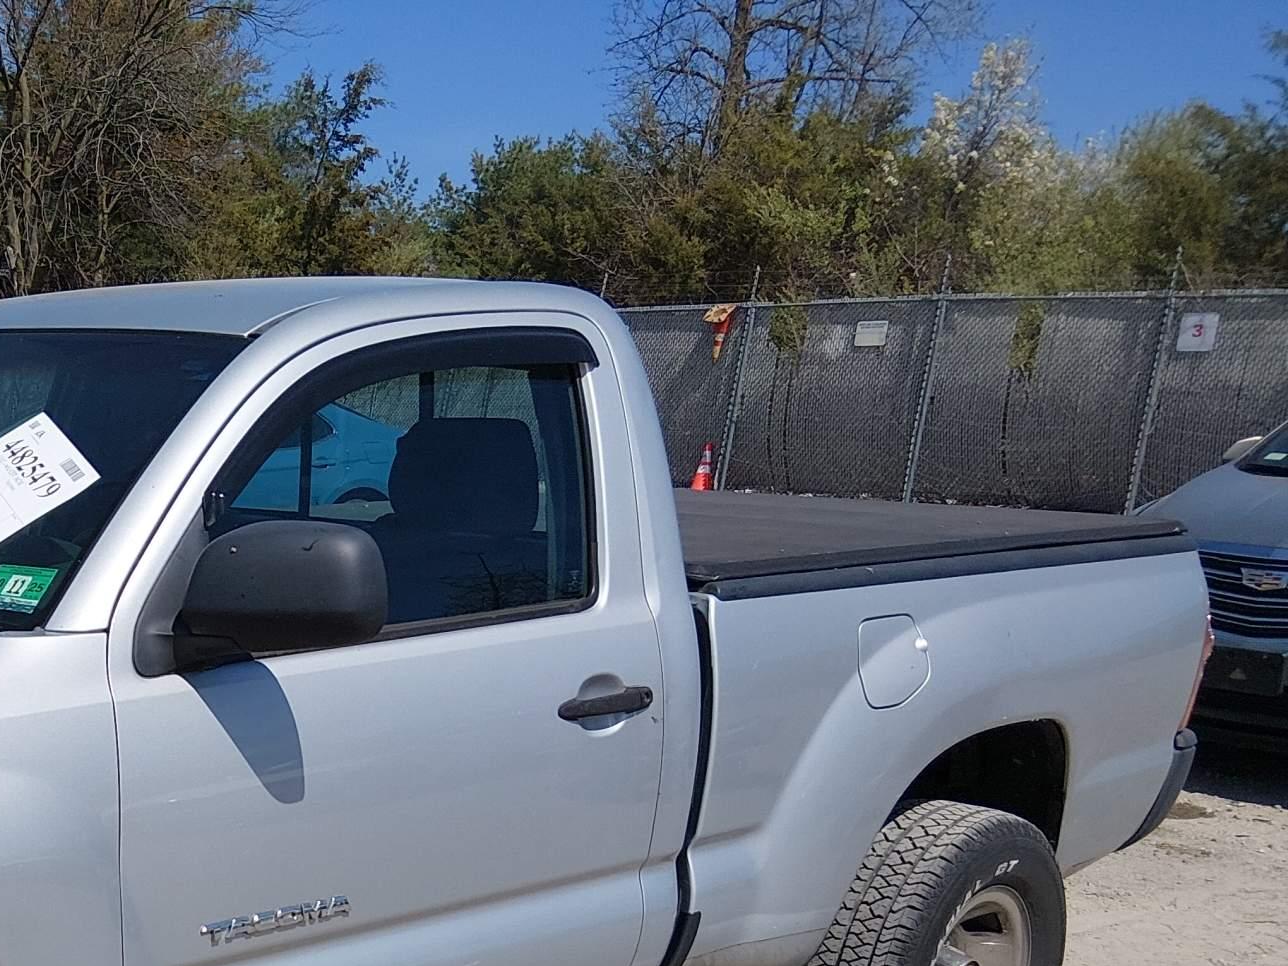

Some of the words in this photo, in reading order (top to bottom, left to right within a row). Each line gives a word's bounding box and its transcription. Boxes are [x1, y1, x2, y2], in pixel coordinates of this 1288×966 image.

[1192, 323, 1203, 338] 3
[3, 439, 62, 498] 44825479
[6, 579, 26, 595] 11
[28, 582, 45, 593] 25
[994, 859, 1020, 877] GT
[199, 895, 352, 948] TACOMA
